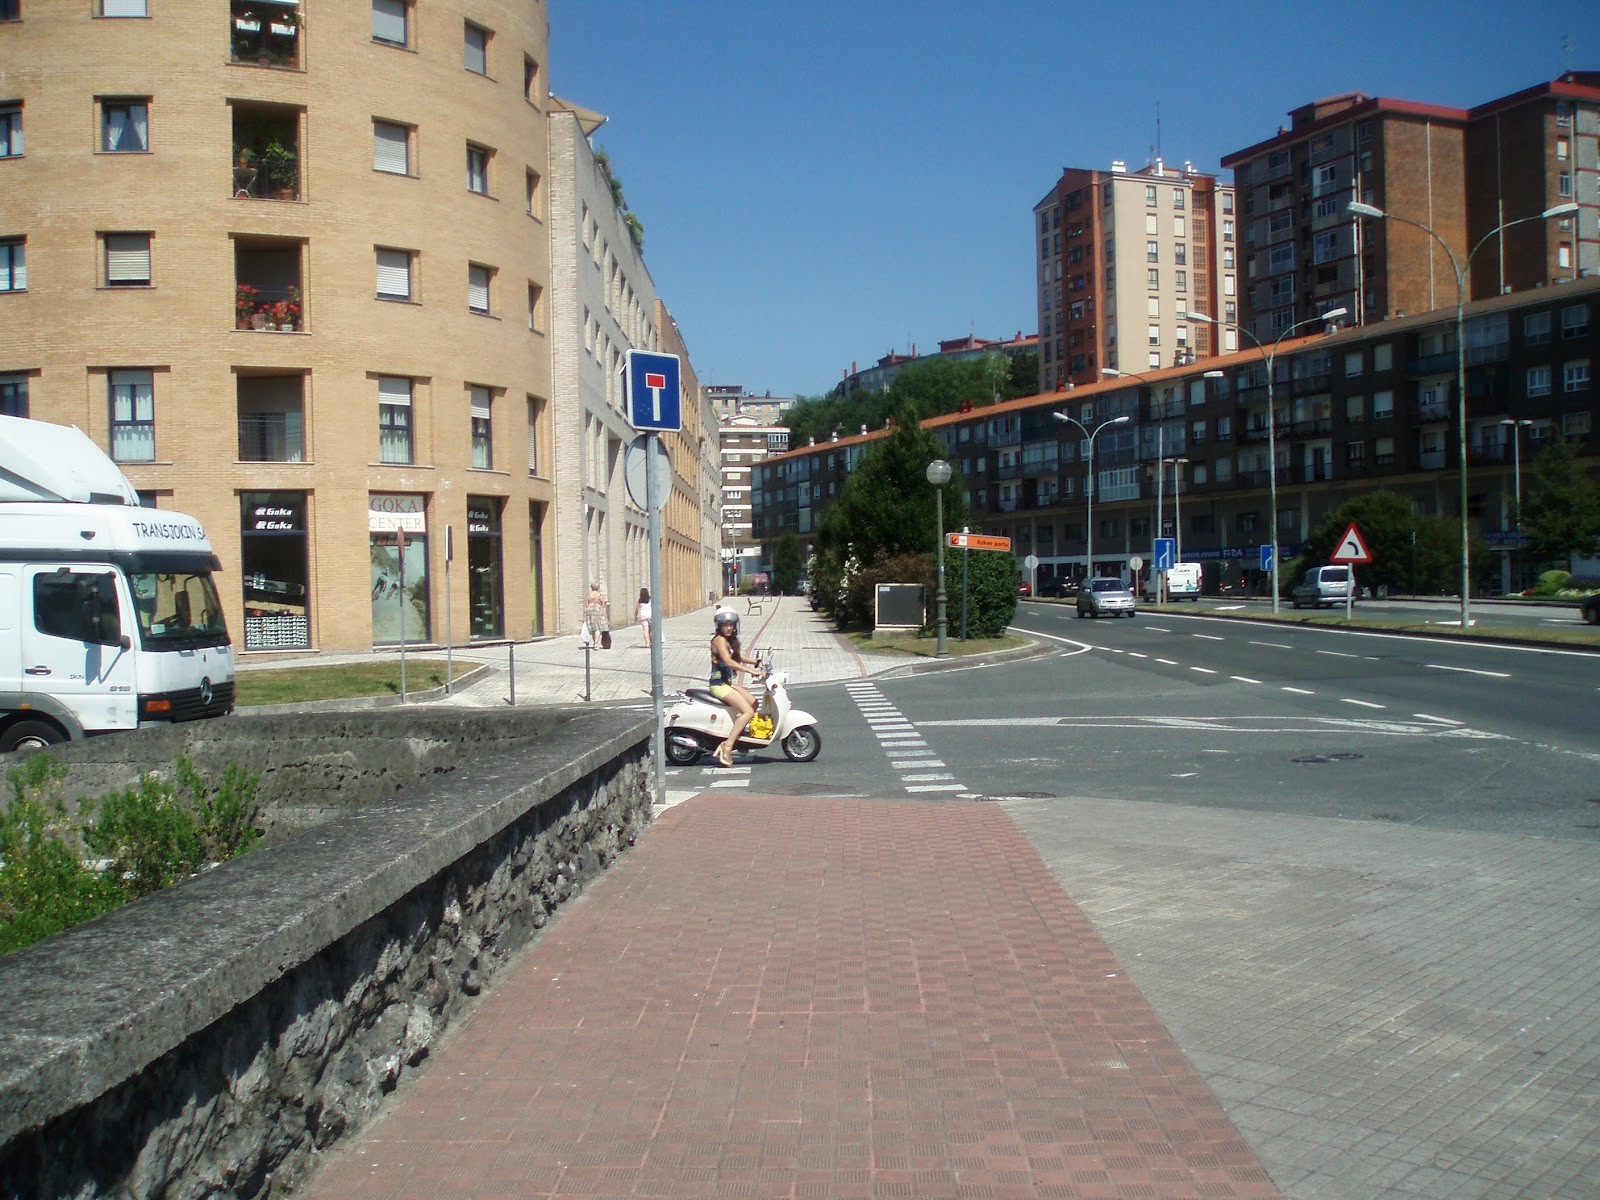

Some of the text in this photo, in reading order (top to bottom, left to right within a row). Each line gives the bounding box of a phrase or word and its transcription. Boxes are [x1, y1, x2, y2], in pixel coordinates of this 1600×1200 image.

[266, 507, 293, 516] Goka
[371, 498, 418, 513] GOKA
[267, 521, 293, 530] Goka
[369, 517, 423, 529] CENTER
[132, 522, 196, 540] TRANSJOKIN
